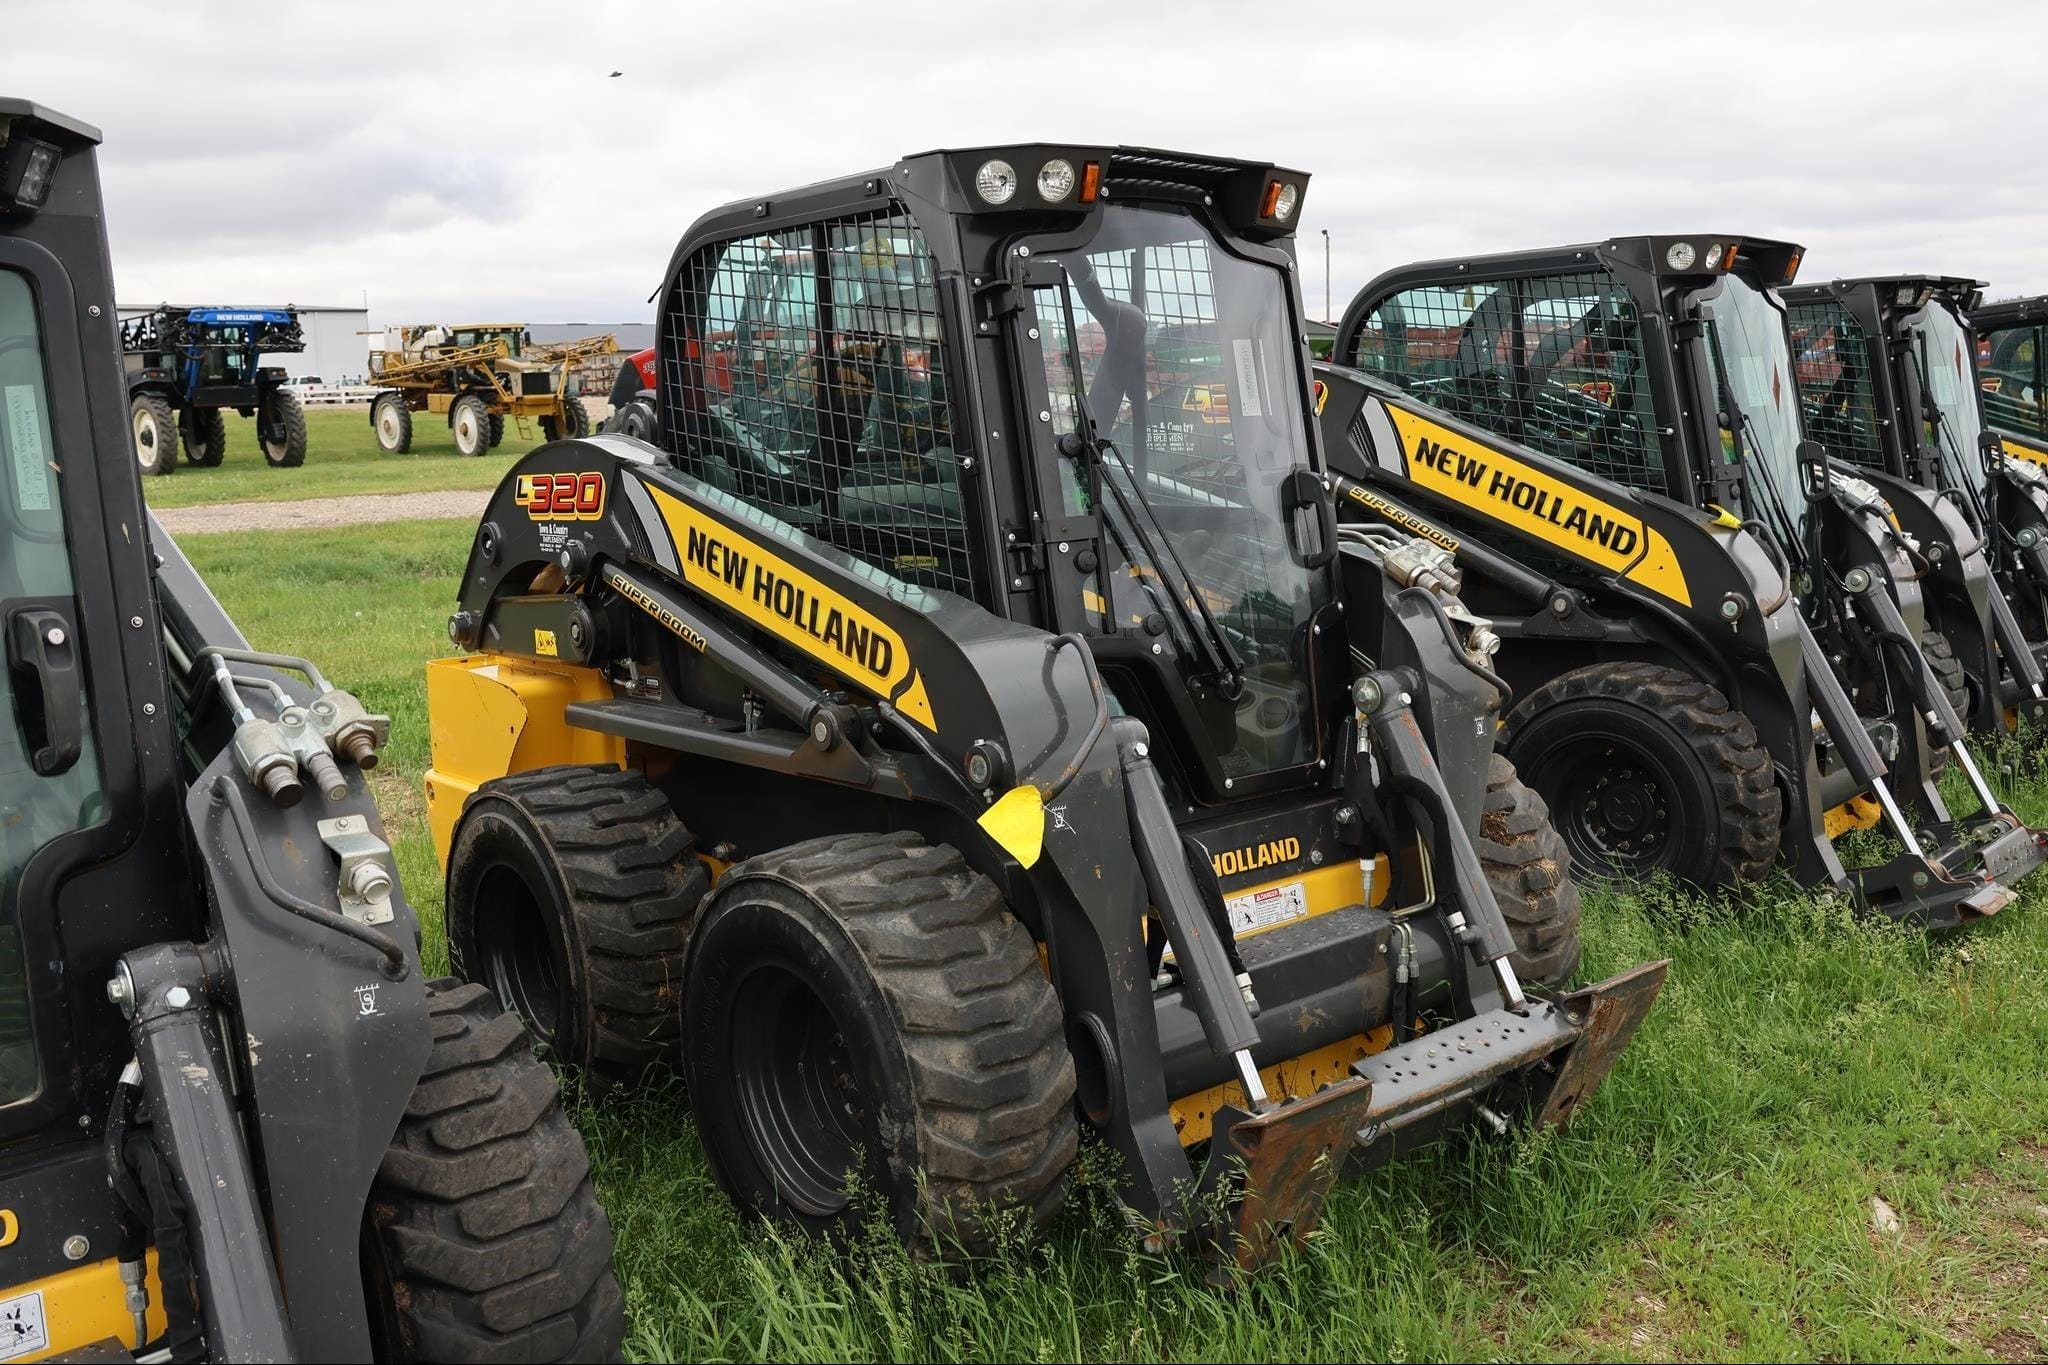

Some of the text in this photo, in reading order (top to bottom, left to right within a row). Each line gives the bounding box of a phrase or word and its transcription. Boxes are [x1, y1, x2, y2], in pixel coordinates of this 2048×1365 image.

[516, 473, 605, 519] L320
[1350, 487, 1459, 551] SUPER BOOM
[1414, 437, 1638, 556] NEW HOLLAND
[612, 575, 706, 653] SUPER BOOM
[687, 526, 893, 679] NEW HOLLAND
